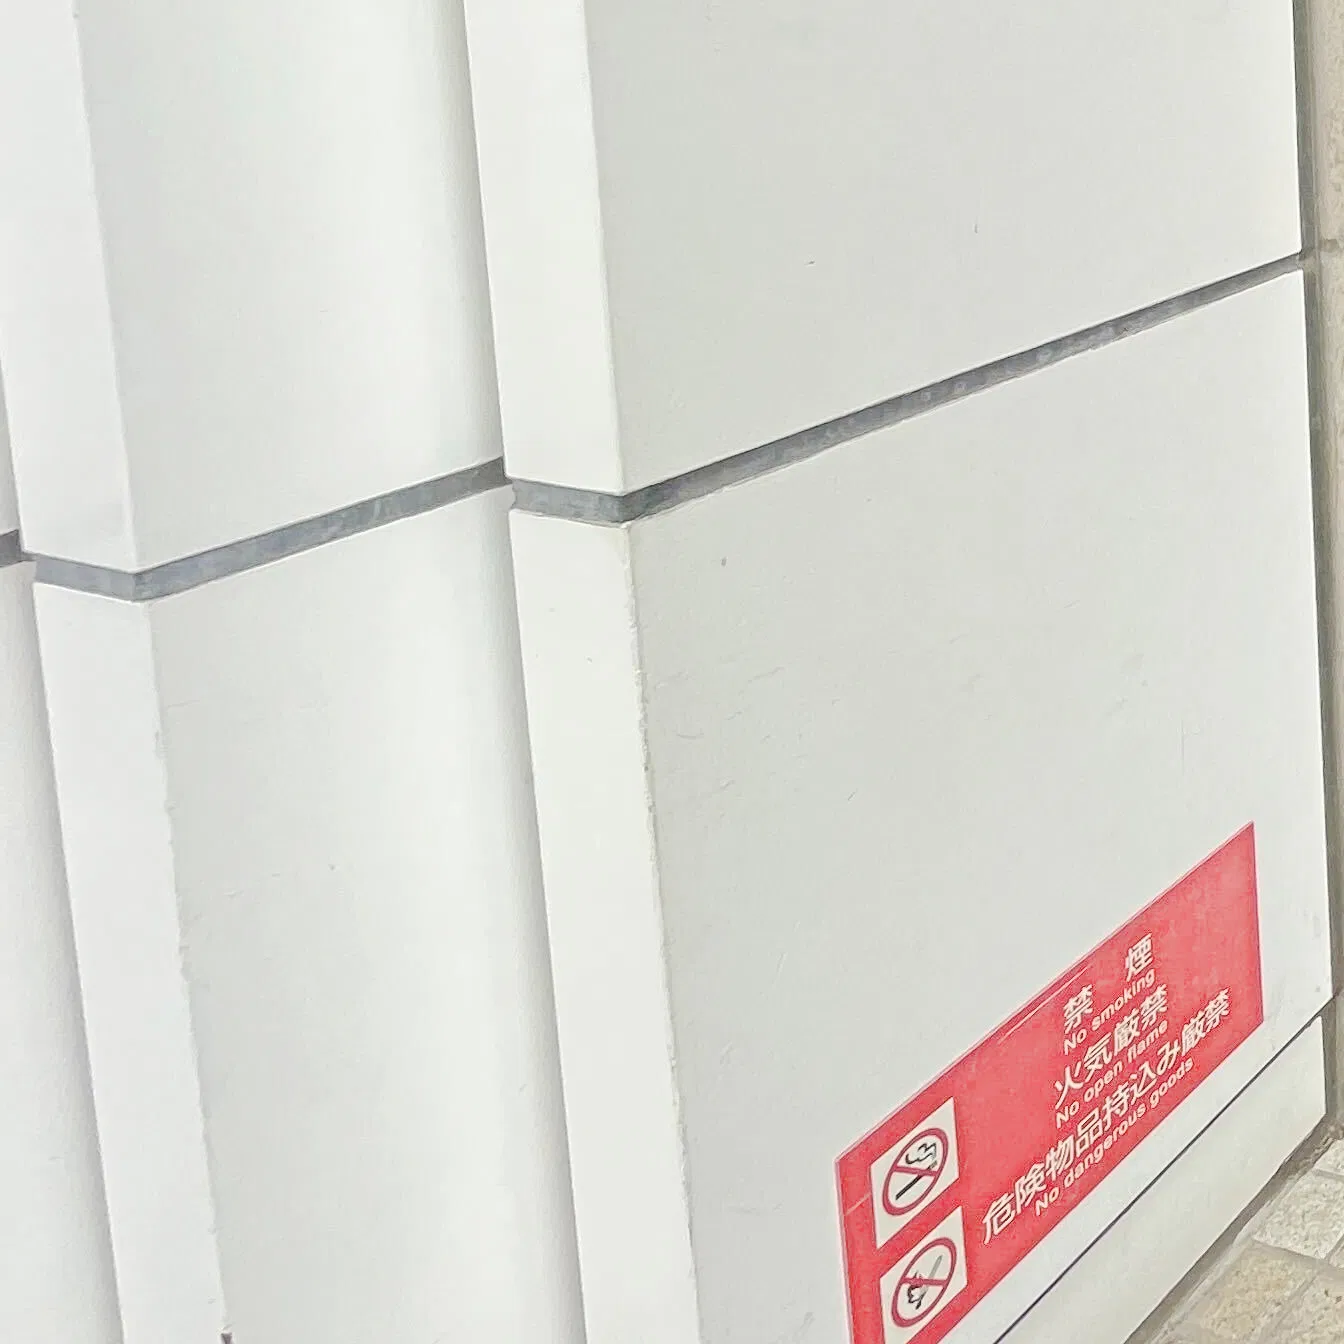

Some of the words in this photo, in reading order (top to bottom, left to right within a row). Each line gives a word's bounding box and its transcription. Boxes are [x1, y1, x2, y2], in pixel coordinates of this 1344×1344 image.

[1054, 983, 1168, 1110] 火気厳禁
[1055, 1102, 1080, 1129] No
[1083, 1062, 1124, 1105] open
[1127, 1019, 1169, 1063] flame
[1062, 1031, 1088, 1056] No
[1091, 967, 1156, 1031] smoking
[982, 987, 1231, 1246] 危険物品持込み厳禁
[1034, 1184, 1060, 1216] No
[1063, 1098, 1147, 1187] dangerous
[1150, 1057, 1195, 1109] goods
